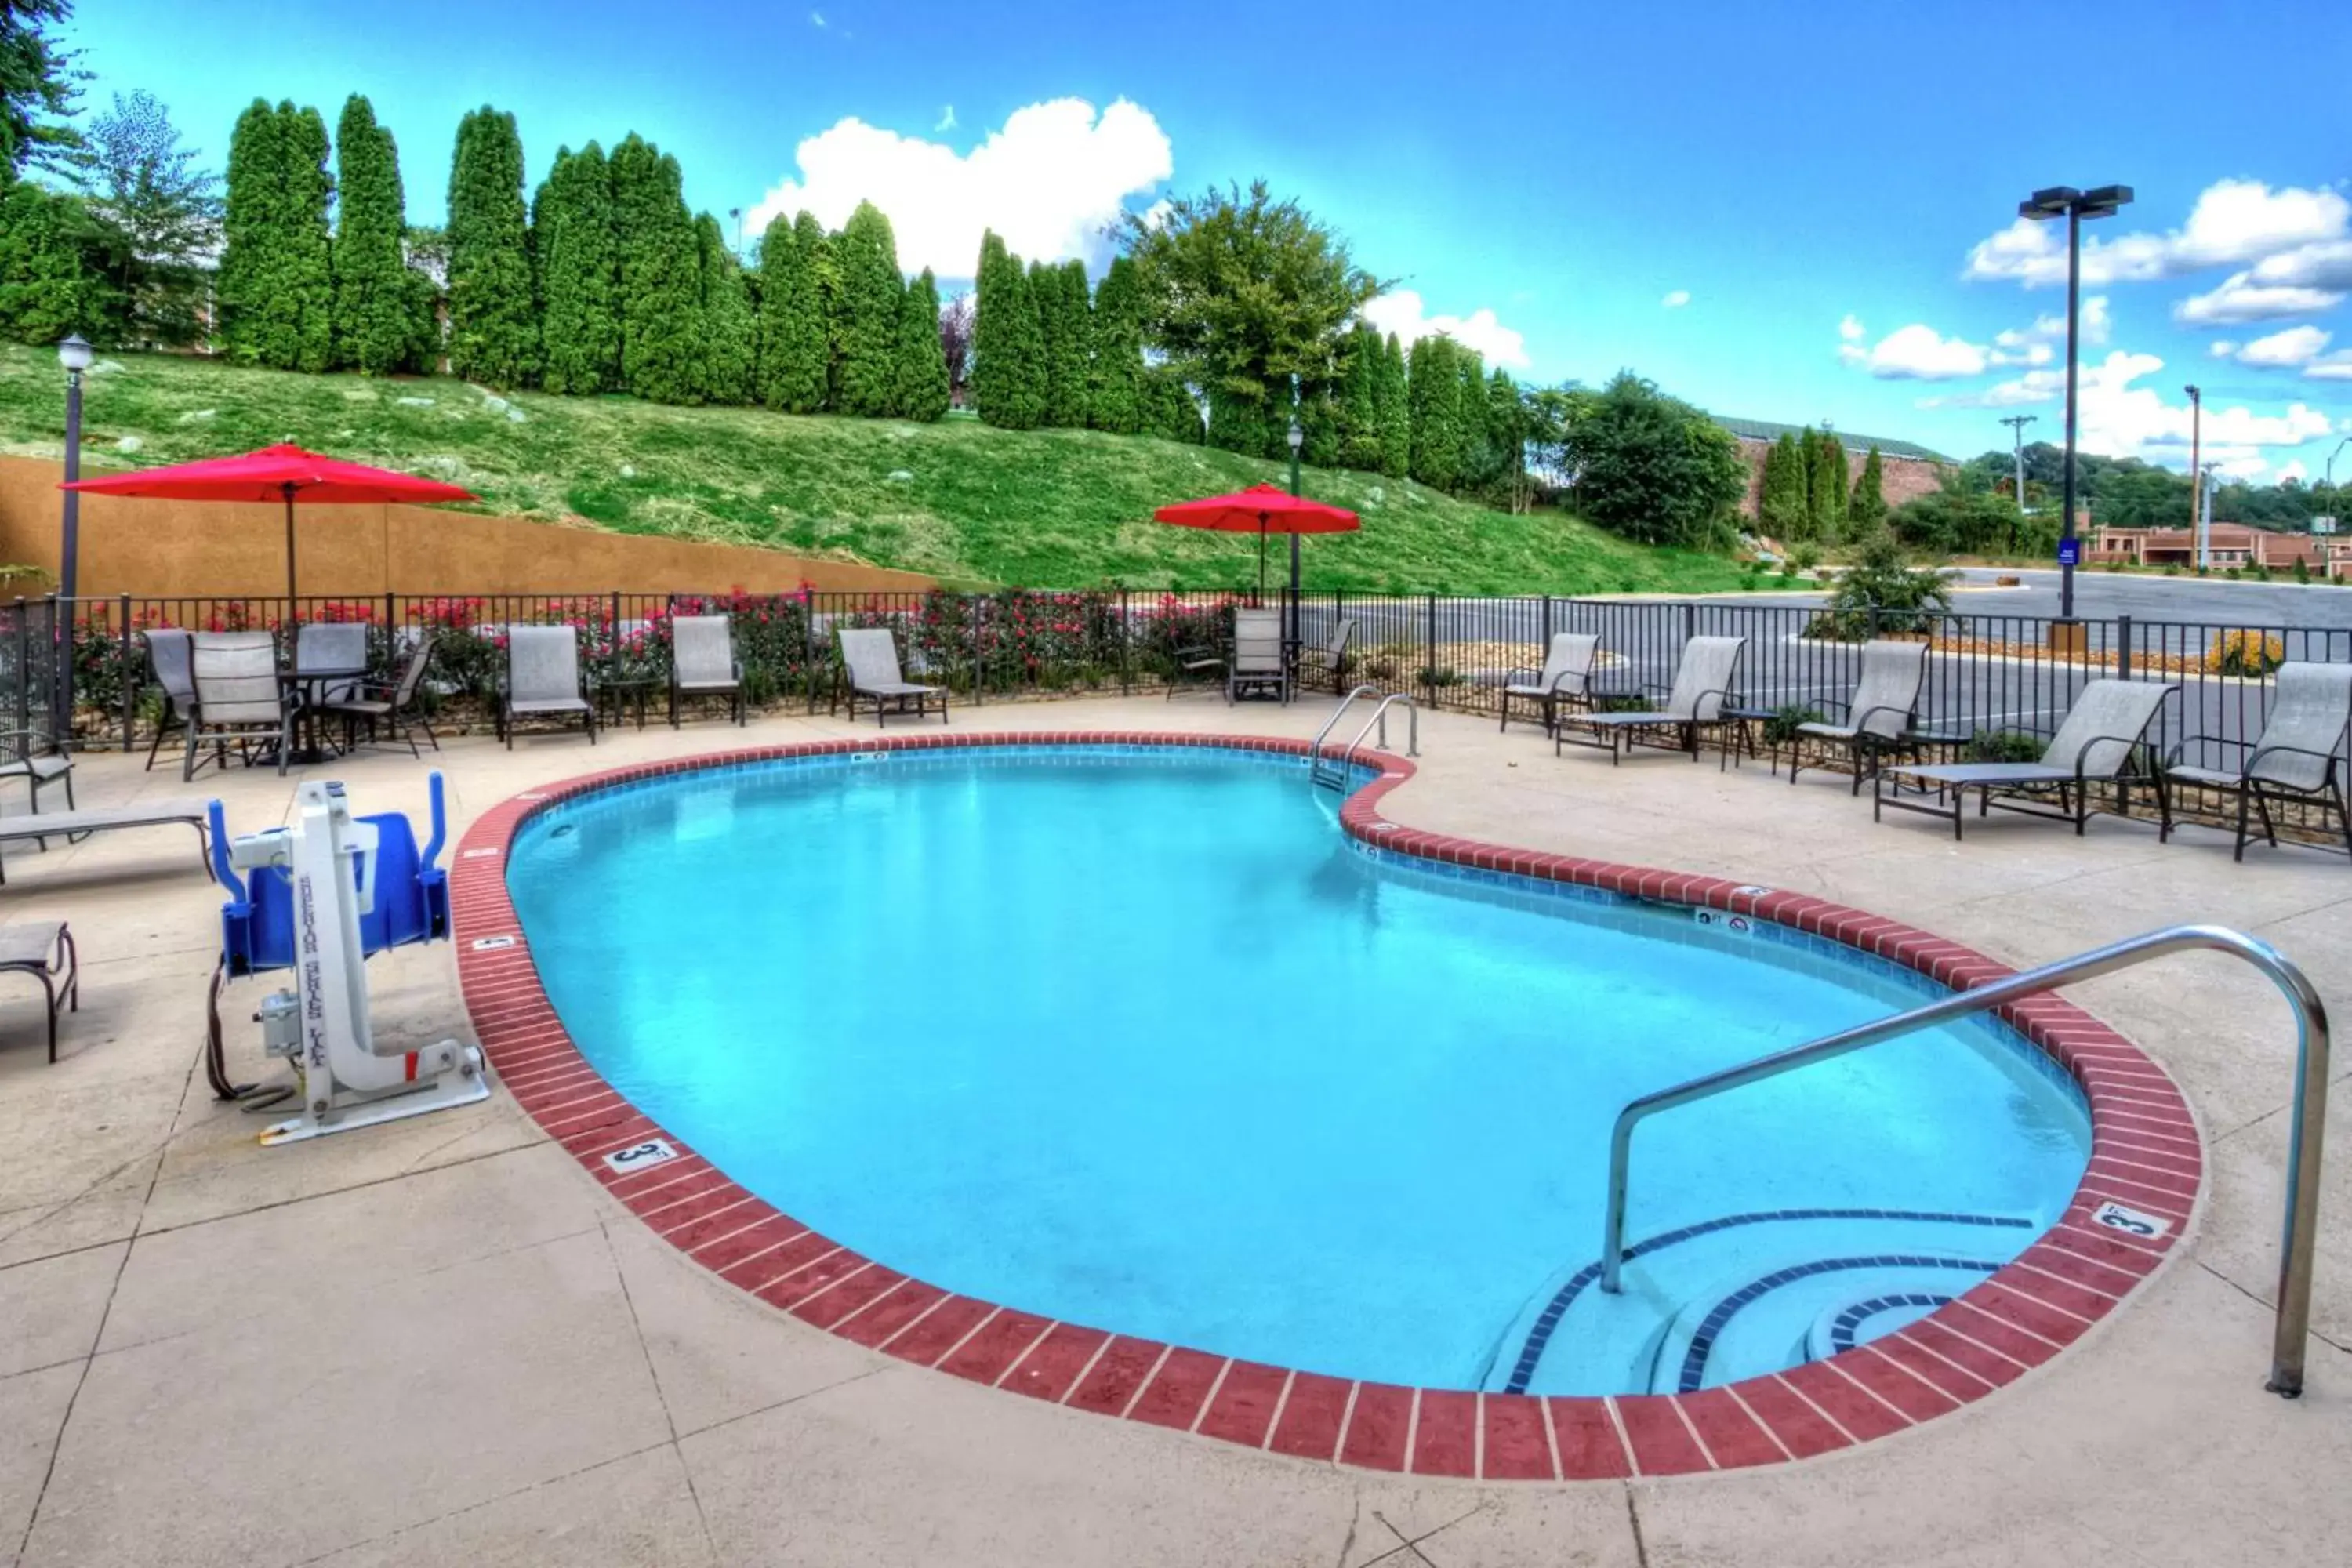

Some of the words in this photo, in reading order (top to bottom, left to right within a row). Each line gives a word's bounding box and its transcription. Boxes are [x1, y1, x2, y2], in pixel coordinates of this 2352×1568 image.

[310, 1028, 325, 1067] LIFT
[614, 1143, 659, 1162] 3
[2101, 1214, 2154, 1235] 3
